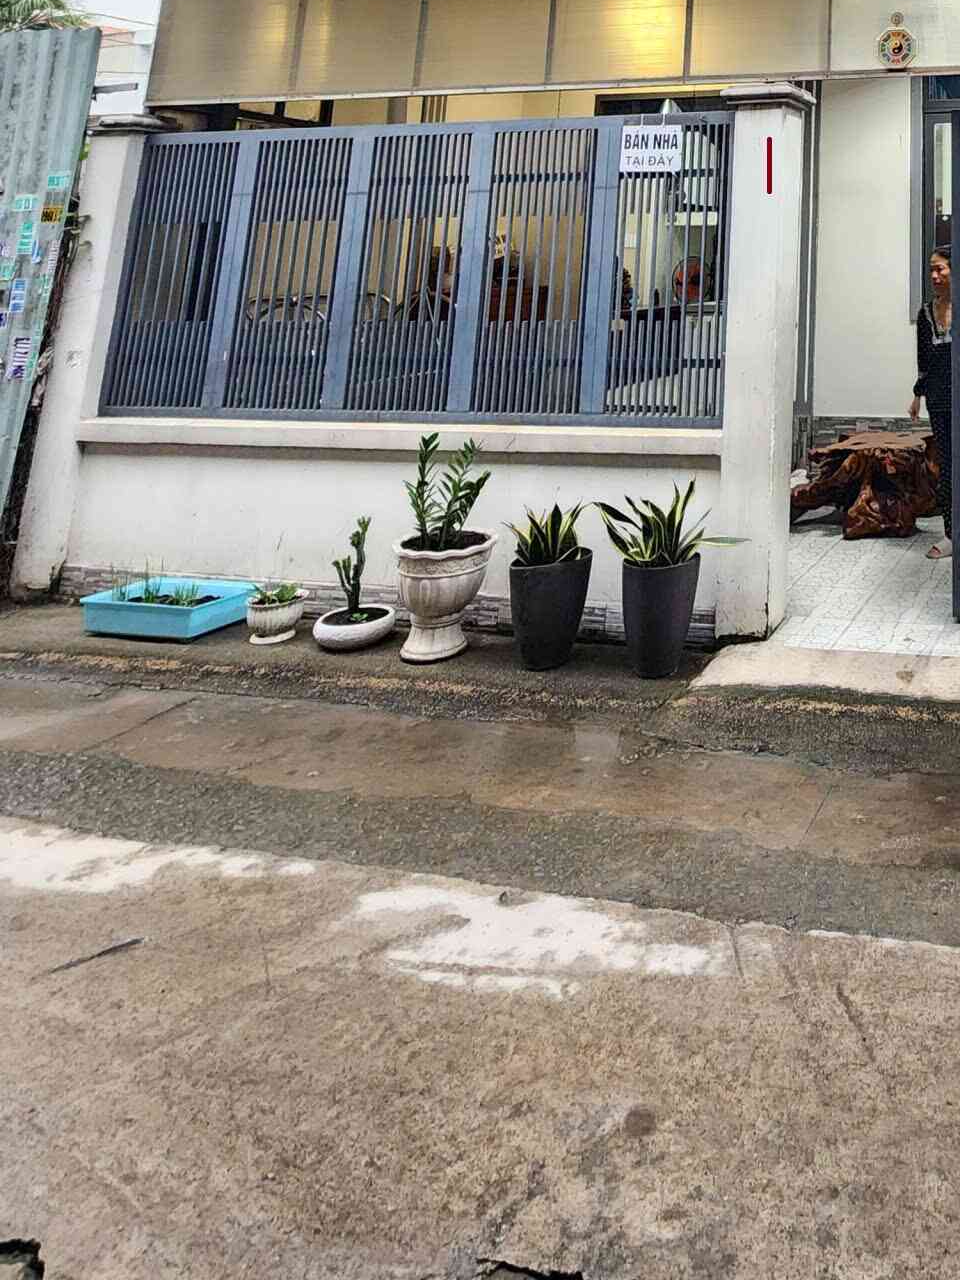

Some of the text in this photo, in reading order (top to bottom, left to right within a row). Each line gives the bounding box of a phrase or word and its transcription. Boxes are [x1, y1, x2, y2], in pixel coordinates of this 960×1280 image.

[624, 129, 678, 150] BÁN NHÀ
[624, 153, 674, 168] TẠI ĐÂY
